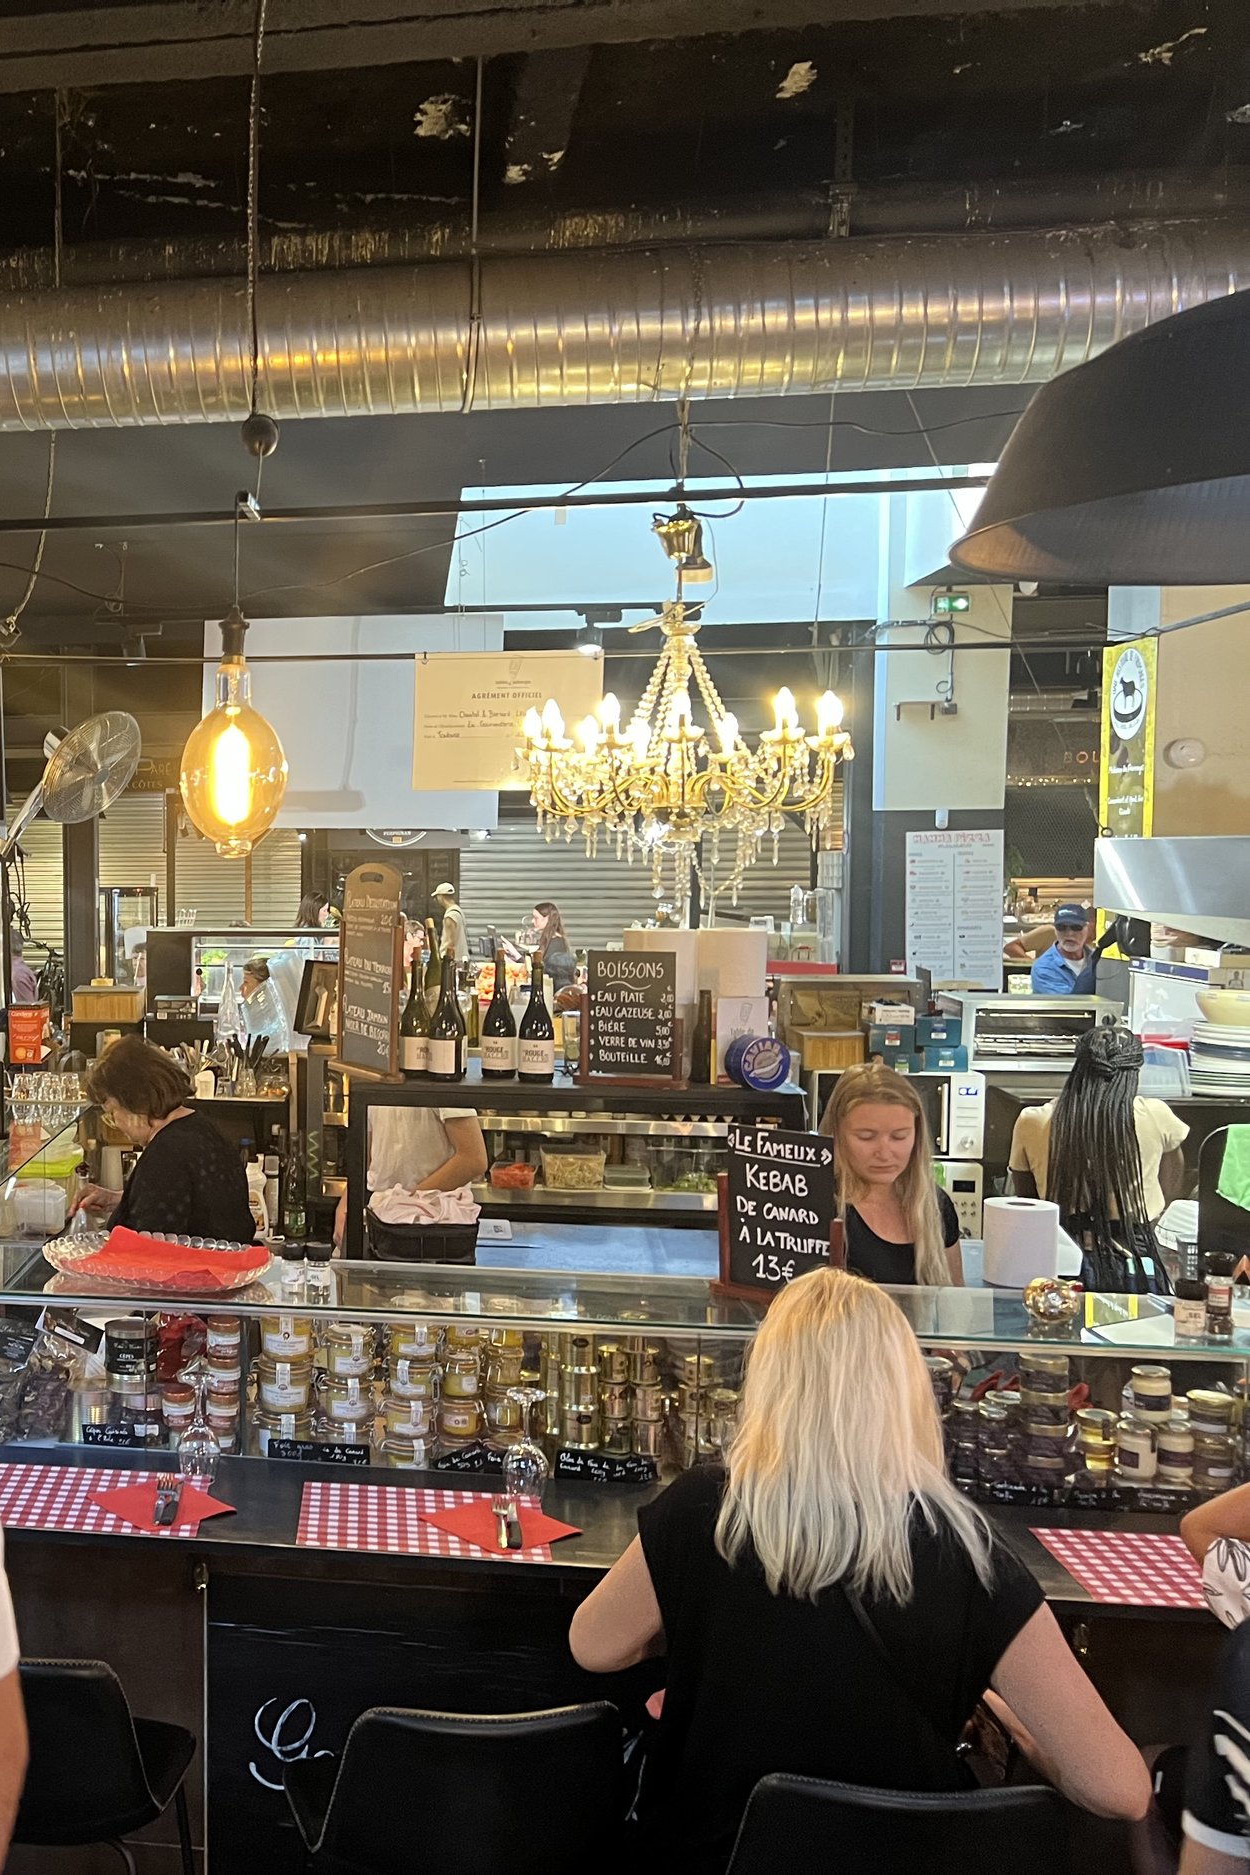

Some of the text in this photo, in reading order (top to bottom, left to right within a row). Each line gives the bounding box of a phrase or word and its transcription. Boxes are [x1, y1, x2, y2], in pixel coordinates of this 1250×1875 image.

[512, 691, 542, 699] OFFICIEL
[597, 961, 664, 979] BOISSONS
[597, 990, 617, 1002] EAU
[620, 990, 645, 1003] PLATE
[595, 1005, 613, 1018] EAU
[614, 1006, 655, 1020] GAZEUSE
[598, 1019, 626, 1033] BIÈRE
[599, 1035, 626, 1048] VERRE
[628, 1037, 638, 1048] DE
[639, 1038, 655, 1049] VIN
[599, 1049, 648, 1064] BOUTEILLE
[745, 1163, 808, 1197] KEBAB
[736, 1195, 819, 1225] DE CANARD
[738, 1217, 830, 1256] À LA TRUFFE
[752, 1253, 795, 1283] 13€
